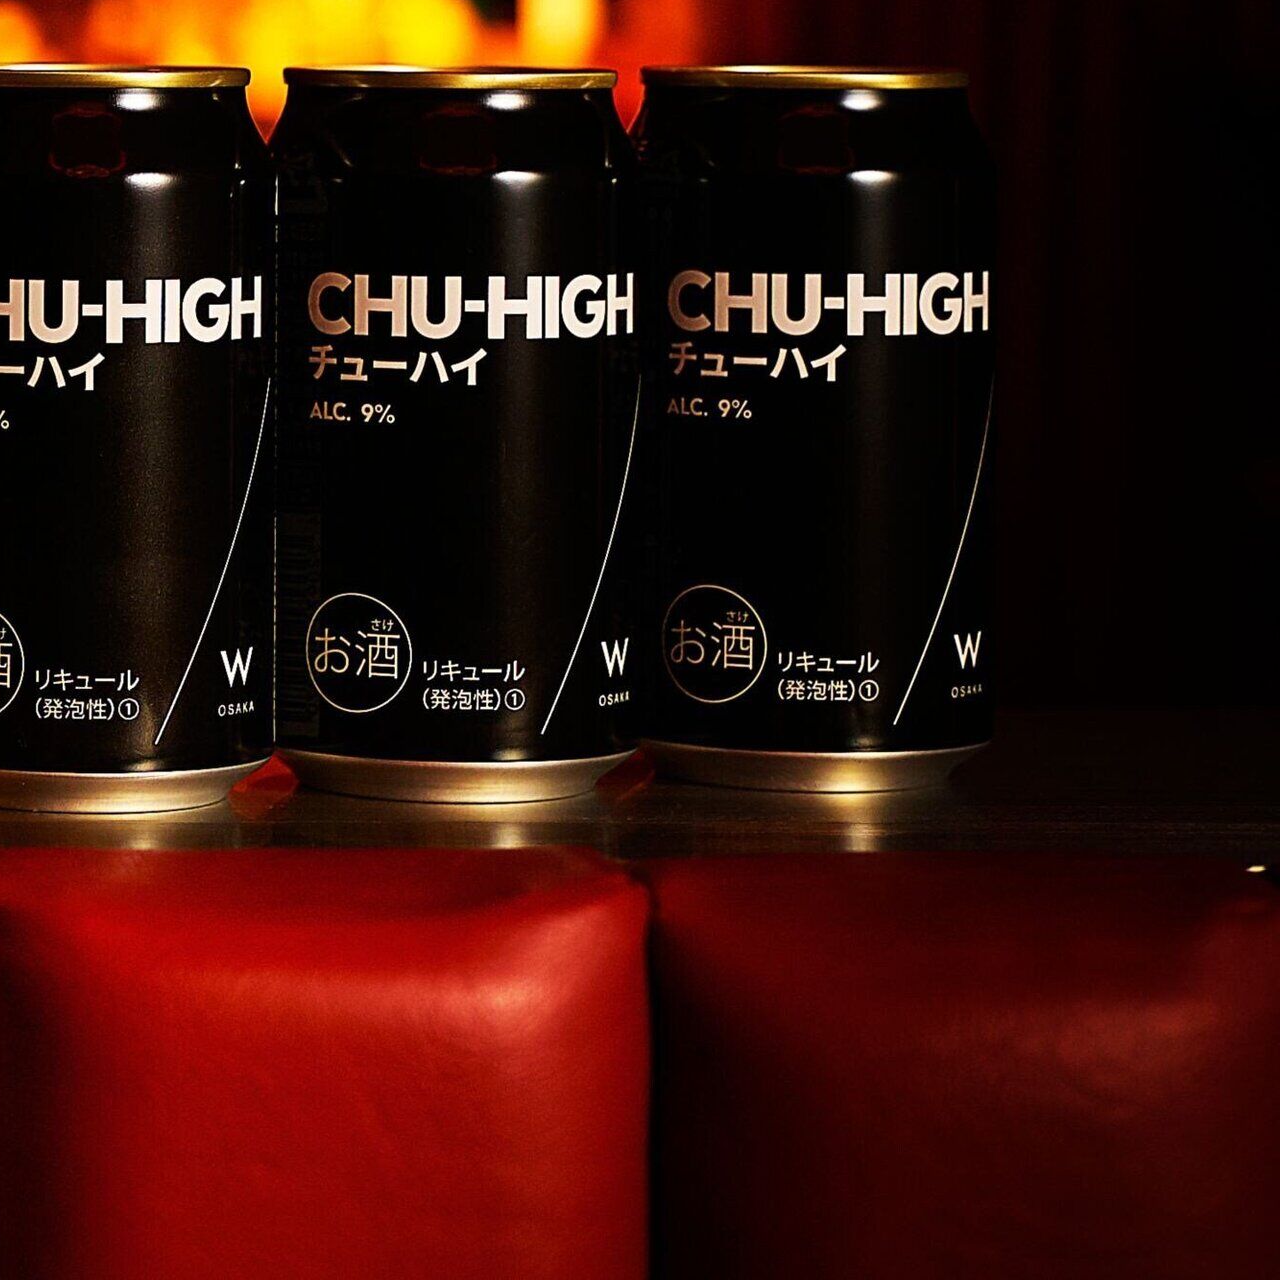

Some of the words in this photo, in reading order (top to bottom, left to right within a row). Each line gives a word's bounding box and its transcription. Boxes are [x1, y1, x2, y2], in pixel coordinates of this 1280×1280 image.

[308, 272, 634, 340] CHU-HIGH
[667, 270, 989, 336] CHU-HIGH
[308, 345, 487, 386] チューハイ
[668, 341, 847, 382] チューハイ
[310, 401, 351, 421] ALC.
[360, 403, 396, 424] 9%
[667, 397, 708, 417] ALC.
[718, 399, 752, 419] 9%
[371, 619, 394, 631] さけ
[726, 611, 749, 623] さけ
[314, 628, 400, 679] お酒
[670, 620, 756, 670] お酒
[953, 630, 982, 669] W
[220, 646, 254, 688] W
[601, 637, 629, 677] W
[778, 652, 880, 673] リキュール
[35, 669, 140, 691] リキュール
[422, 660, 525, 682] リキュール
[599, 691, 630, 707] OSAKA
[951, 683, 983, 699] OSAKA
[218, 700, 255, 717] OSAKA
